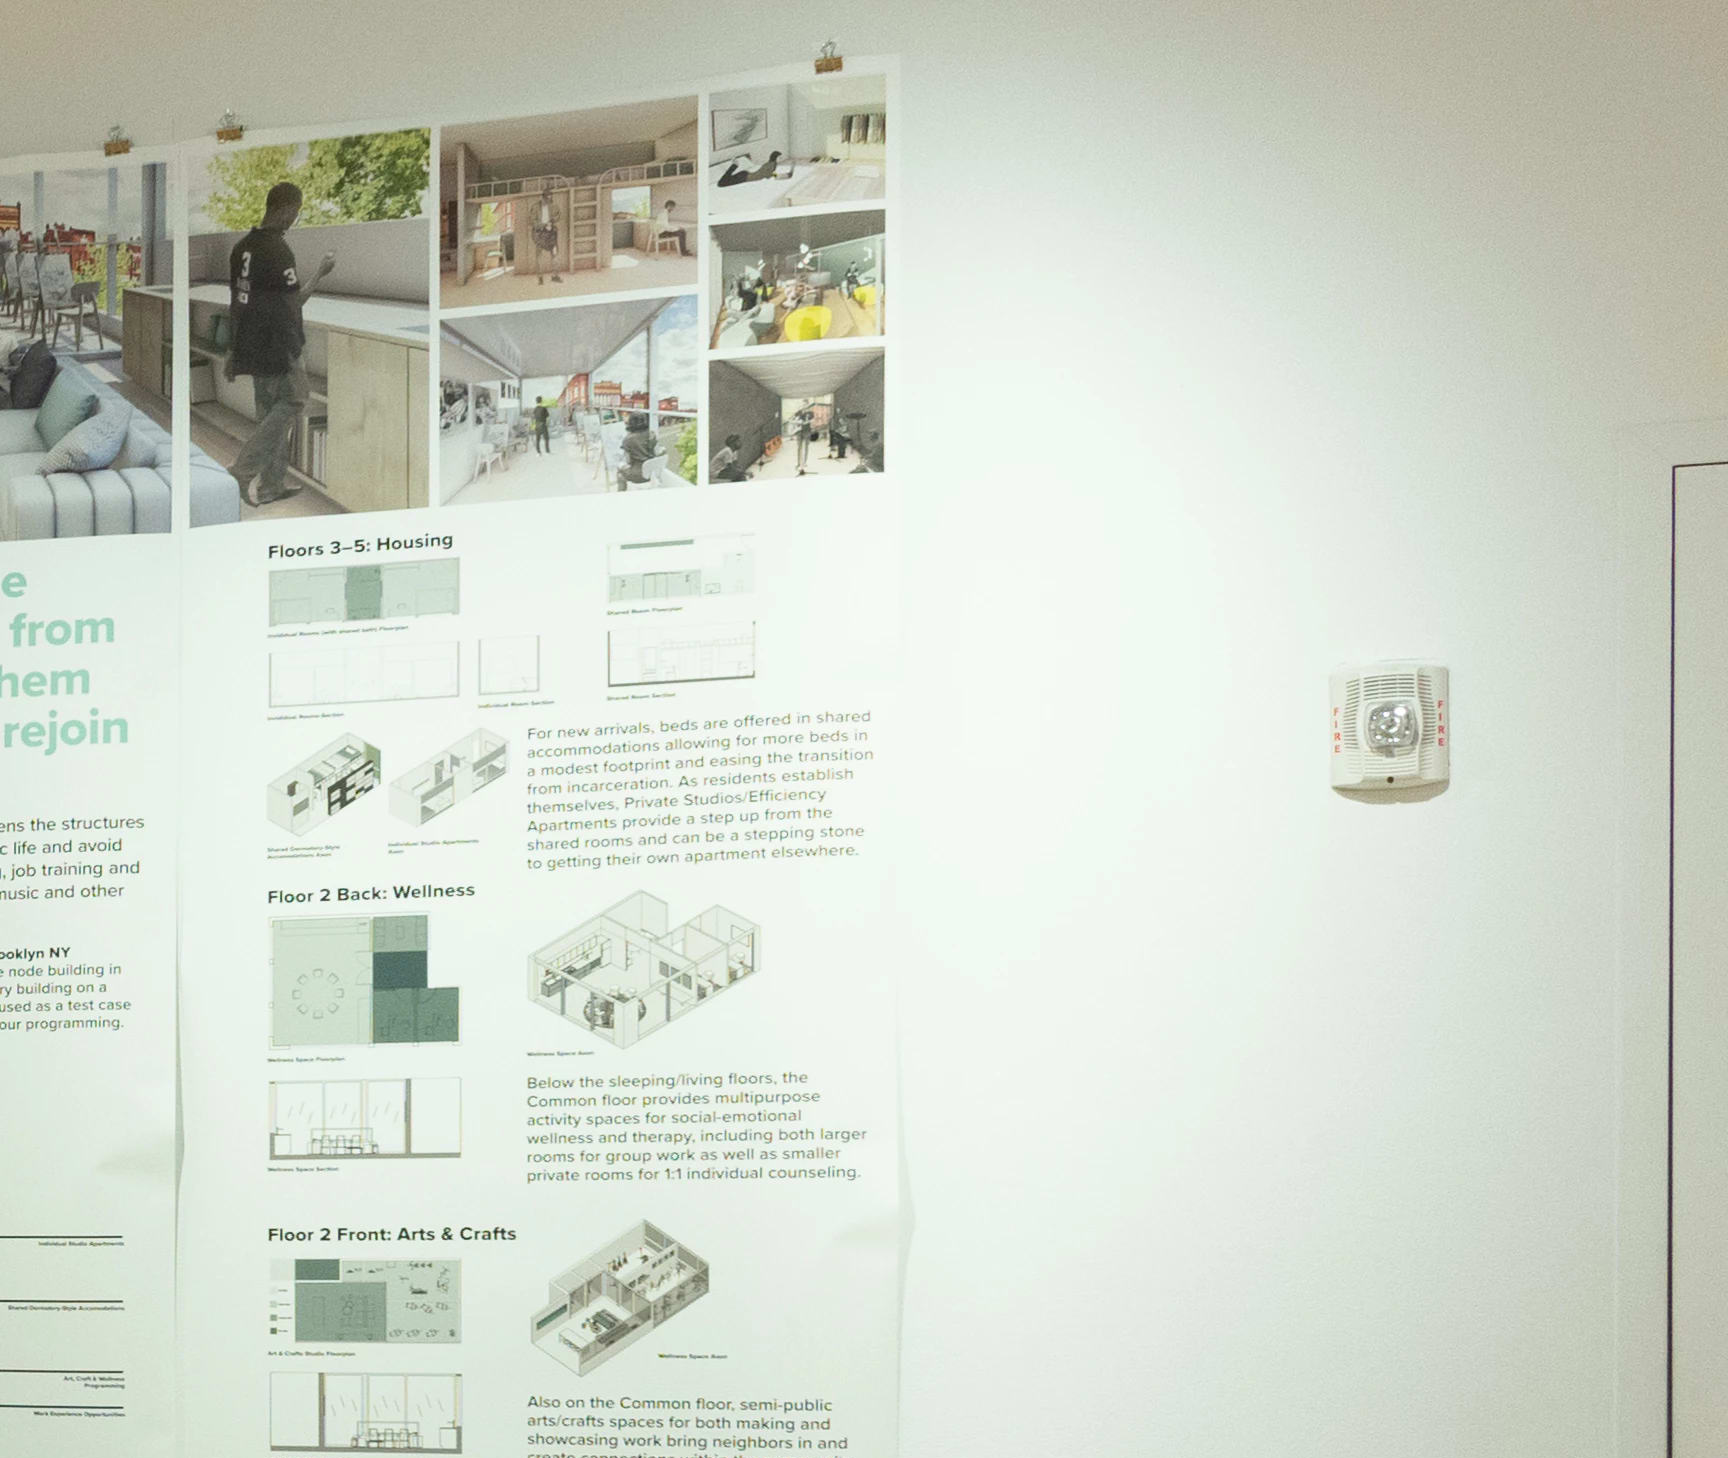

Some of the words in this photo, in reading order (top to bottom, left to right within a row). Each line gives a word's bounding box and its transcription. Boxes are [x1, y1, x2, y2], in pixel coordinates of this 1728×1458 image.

[269, 545, 324, 558] Floors
[377, 534, 452, 551] Housing
[9, 615, 114, 647] from
[4, 710, 128, 756] rejoin
[1333, 707, 1341, 754] FIRE
[1437, 700, 1445, 747] FIRE
[30, 818, 56, 831] the
[62, 818, 144, 830] structures
[268, 890, 313, 903] Floor
[320, 889, 330, 901] 2
[338, 887, 387, 901] Back:
[393, 885, 475, 899] Wellness
[50, 947, 70, 958] NY
[269, 1228, 314, 1241] Floor
[320, 1228, 330, 1241] 2
[338, 1228, 391, 1241] Front:
[397, 1228, 435, 1240] Arts
[441, 1227, 453, 1240] &
[460, 1227, 516, 1240] Crafts
[528, 1396, 561, 1408] Also
[565, 1399, 585, 1408] on
[590, 1397, 615, 1408] the
[620, 1397, 691, 1409] Common
[740, 1399, 832, 1414] semi-public
